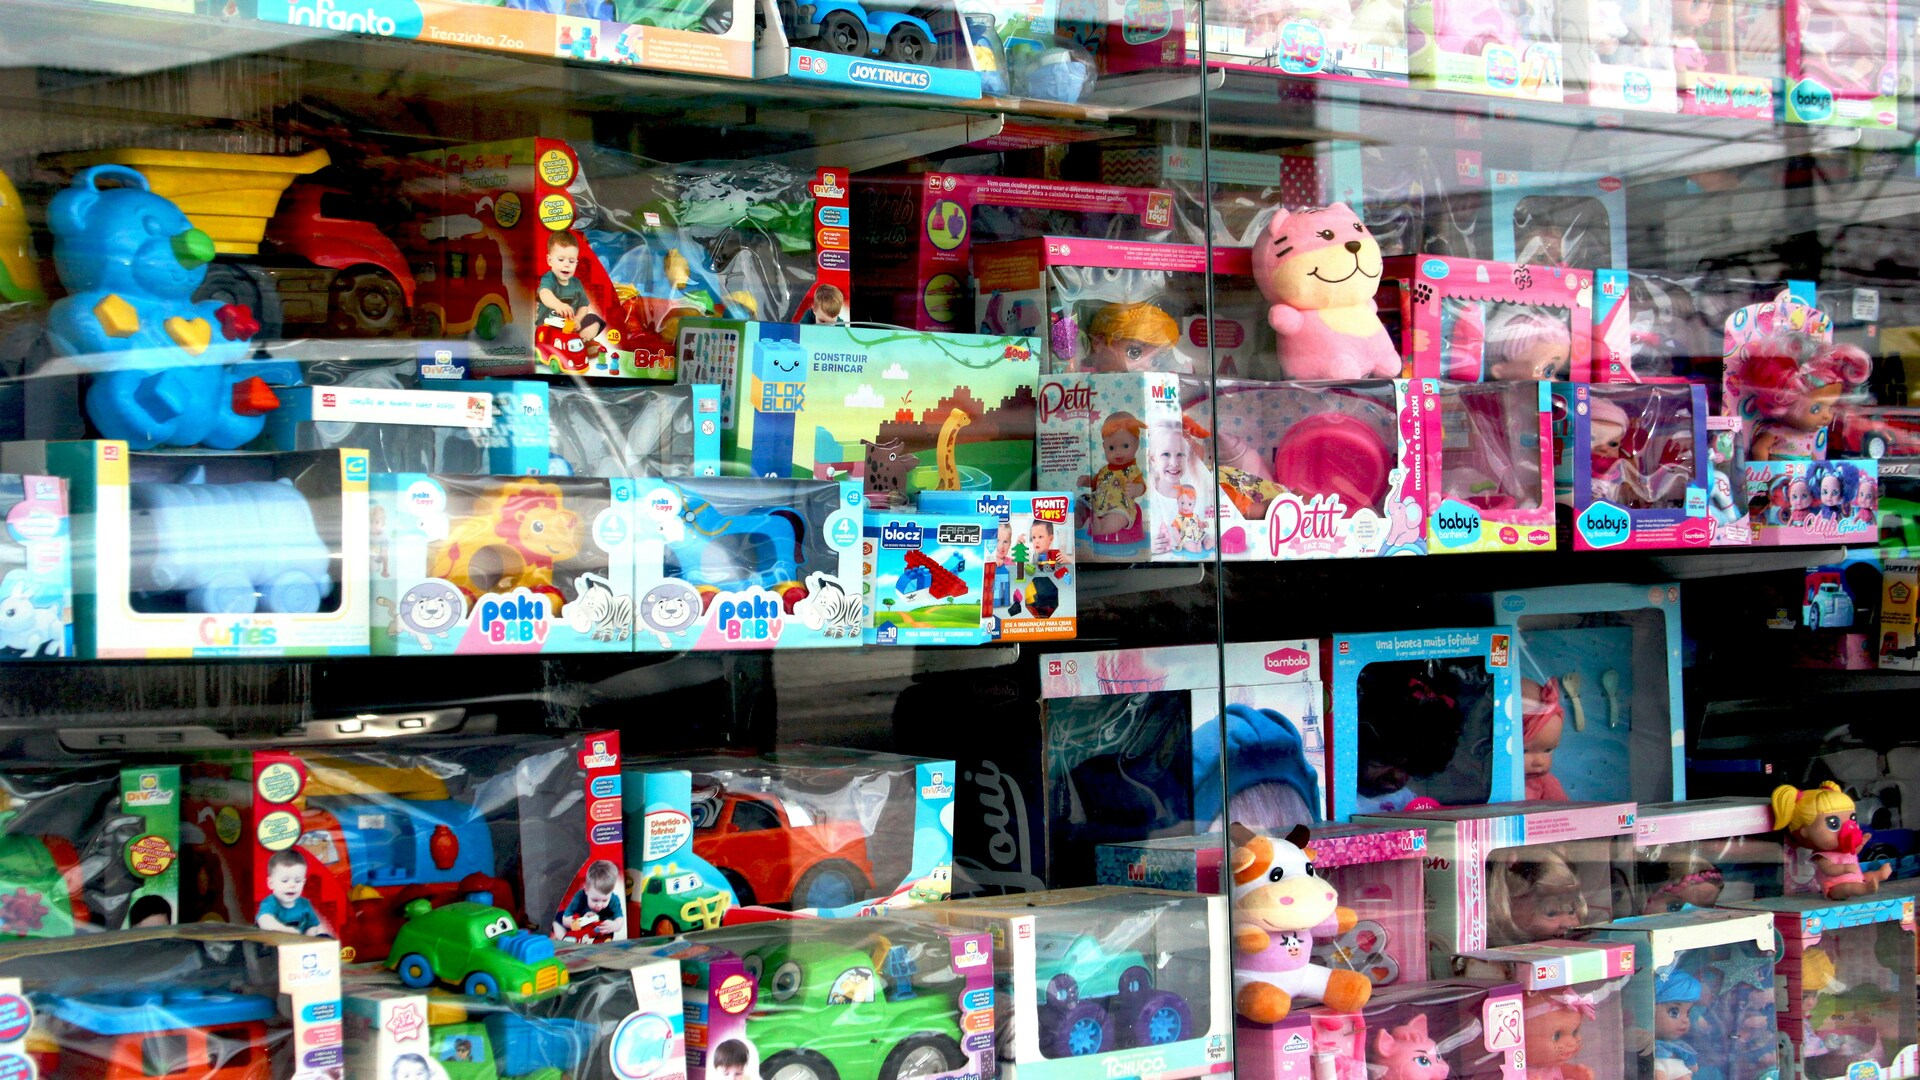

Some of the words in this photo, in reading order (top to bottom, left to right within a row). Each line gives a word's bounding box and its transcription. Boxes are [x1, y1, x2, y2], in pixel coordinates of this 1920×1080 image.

[287, 0, 396, 36] infanto
[429, 26, 495, 46] Trenzinho
[500, 34, 524, 49] Zoo
[544, 200, 564, 209] Peças
[1154, 205, 1167, 214] Bee
[542, 213, 573, 223] encaixes!
[1149, 209, 1167, 223] Toys
[814, 352, 867, 363] CONSTRUIR
[814, 363, 819, 371] E
[821, 363, 863, 373] BRINCAR
[763, 384, 805, 398] BLOK
[762, 398, 805, 412] BLOK
[1039, 381, 1099, 424] Petit
[1412, 421, 1421, 442] faz
[978, 502, 1009, 517] blocz
[1034, 499, 1066, 511] MONTE
[1040, 509, 1060, 520] TOYS
[838, 518, 850, 532] 4
[1269, 489, 1343, 557] Petit
[1439, 512, 1479, 533] baby's
[1587, 514, 1628, 534] baby's
[1803, 512, 1838, 534] Club
[885, 528, 920, 541] blocz
[940, 534, 979, 543] PLANE
[1684, 532, 1706, 540] bambola
[1885, 564, 1907, 572] SUPER
[482, 594, 544, 633] paki
[719, 594, 778, 631] paki
[198, 616, 277, 646] Cuties
[491, 620, 548, 642] BABY
[727, 619, 783, 640] BABY
[887, 627, 897, 638] 10
[1394, 636, 1422, 649] boneca
[1423, 636, 1447, 648] muito
[1447, 633, 1480, 648] fofinha!
[1267, 655, 1309, 669] bambola
[1490, 652, 1507, 665] Toys
[1050, 664, 1061, 673] 3+
[144, 838, 166, 849] Super
[130, 845, 176, 859] engrenagens
[136, 861, 161, 872] giram!
[143, 855, 158, 865] que
[715, 980, 753, 997] Ferramentas
[723, 996, 750, 1009] brincar!
[728, 991, 743, 1002] para
